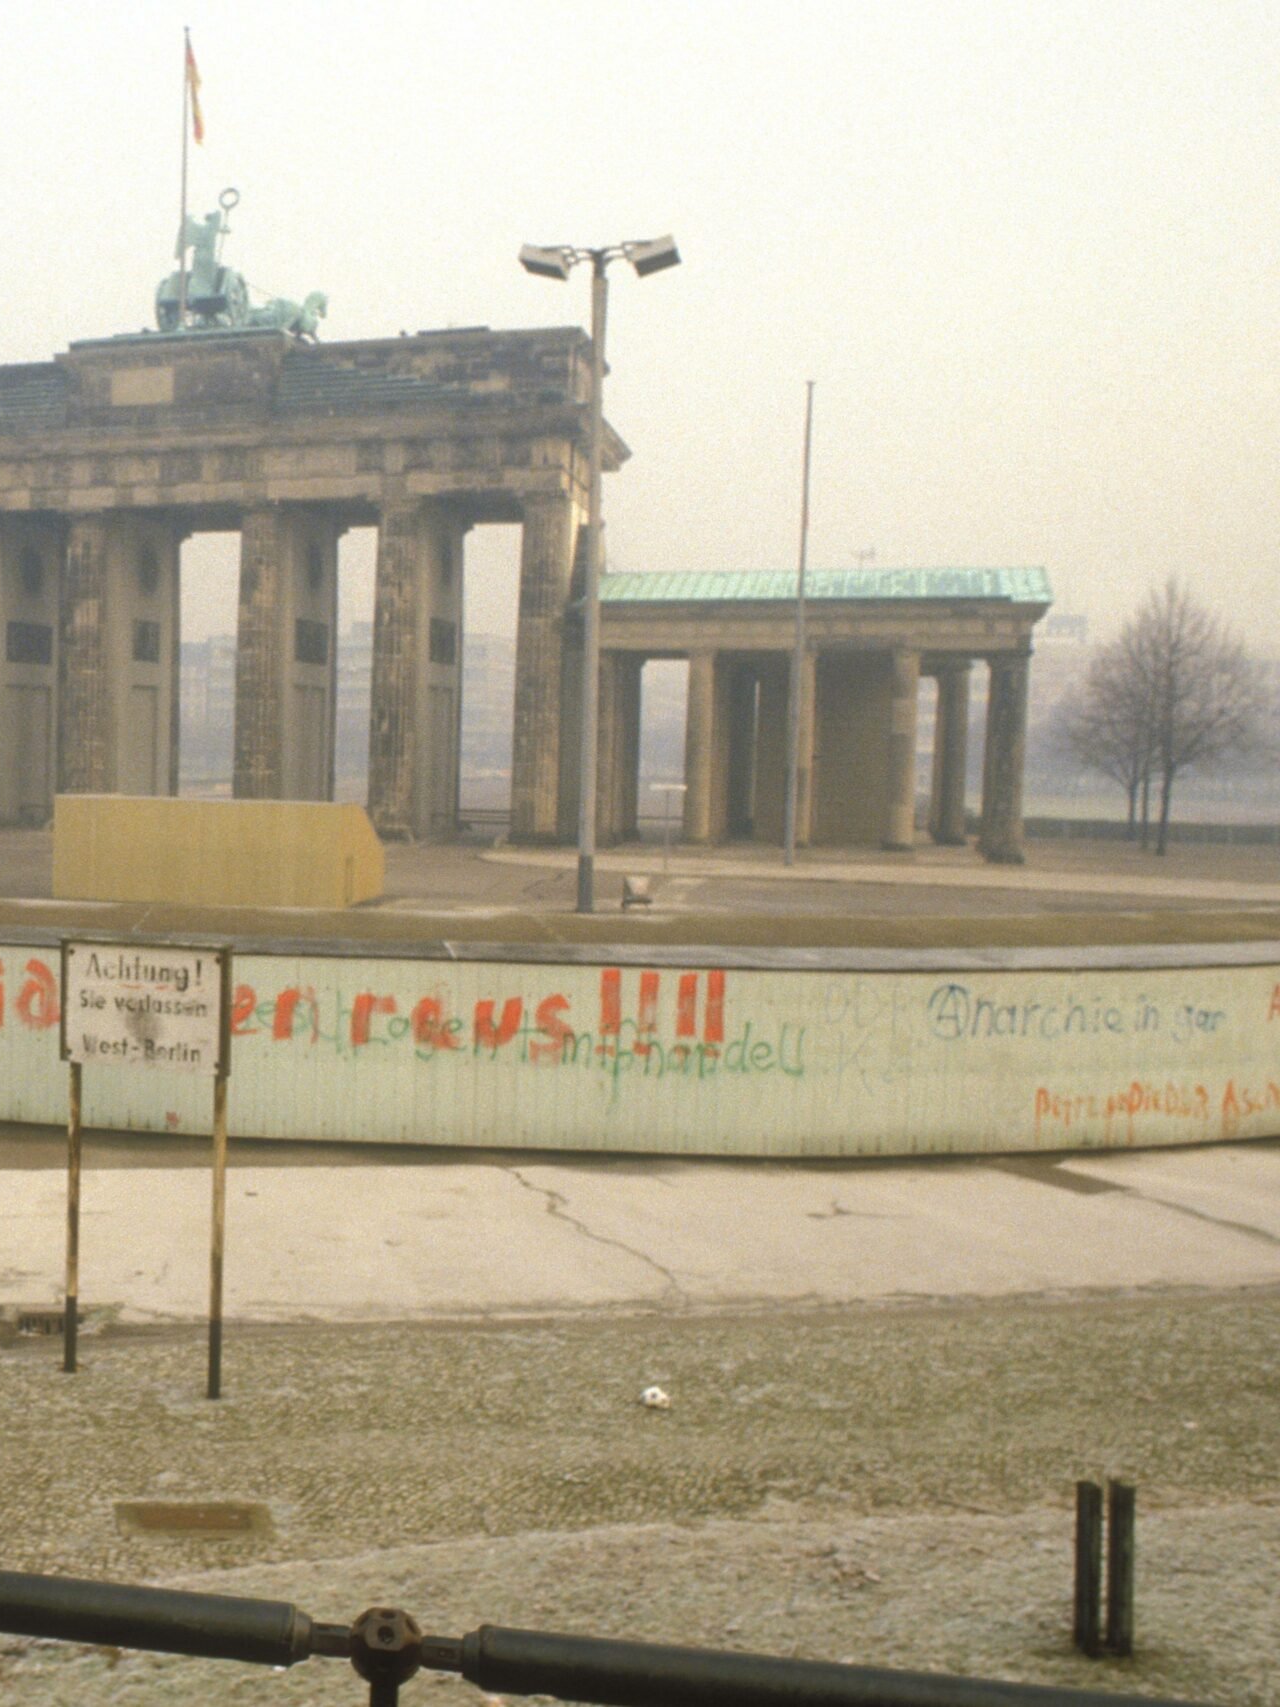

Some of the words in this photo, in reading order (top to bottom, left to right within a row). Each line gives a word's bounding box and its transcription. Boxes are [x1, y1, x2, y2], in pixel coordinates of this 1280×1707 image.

[85, 952, 202, 992] Achtung!
[79, 988, 107, 1010] Sie
[114, 994, 208, 1018] verlassen
[82, 1033, 201, 1063] West-Berlin
